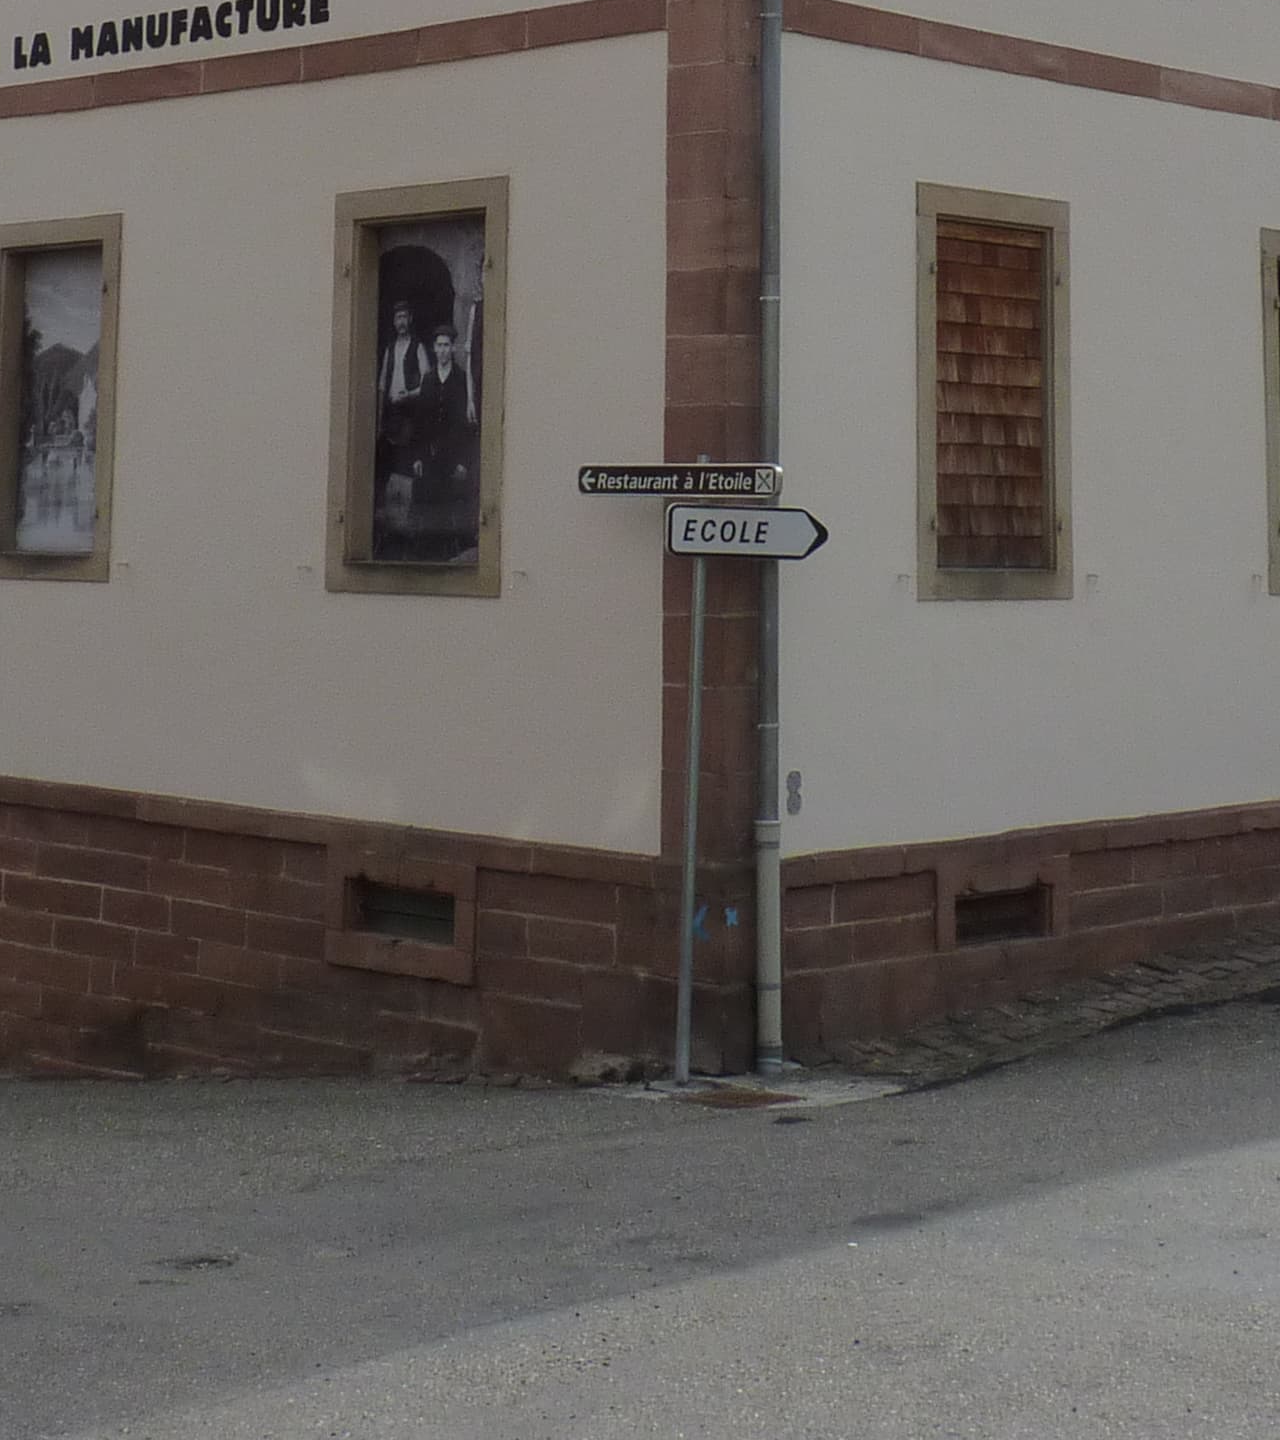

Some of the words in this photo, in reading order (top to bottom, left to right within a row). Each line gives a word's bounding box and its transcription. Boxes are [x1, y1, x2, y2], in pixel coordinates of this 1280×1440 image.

[14, 32, 52, 68] LA
[596, 471, 679, 490] Restaurant
[683, 472, 694, 490] à
[699, 472, 753, 491] l'Etoile
[682, 519, 769, 544] ECOLE
